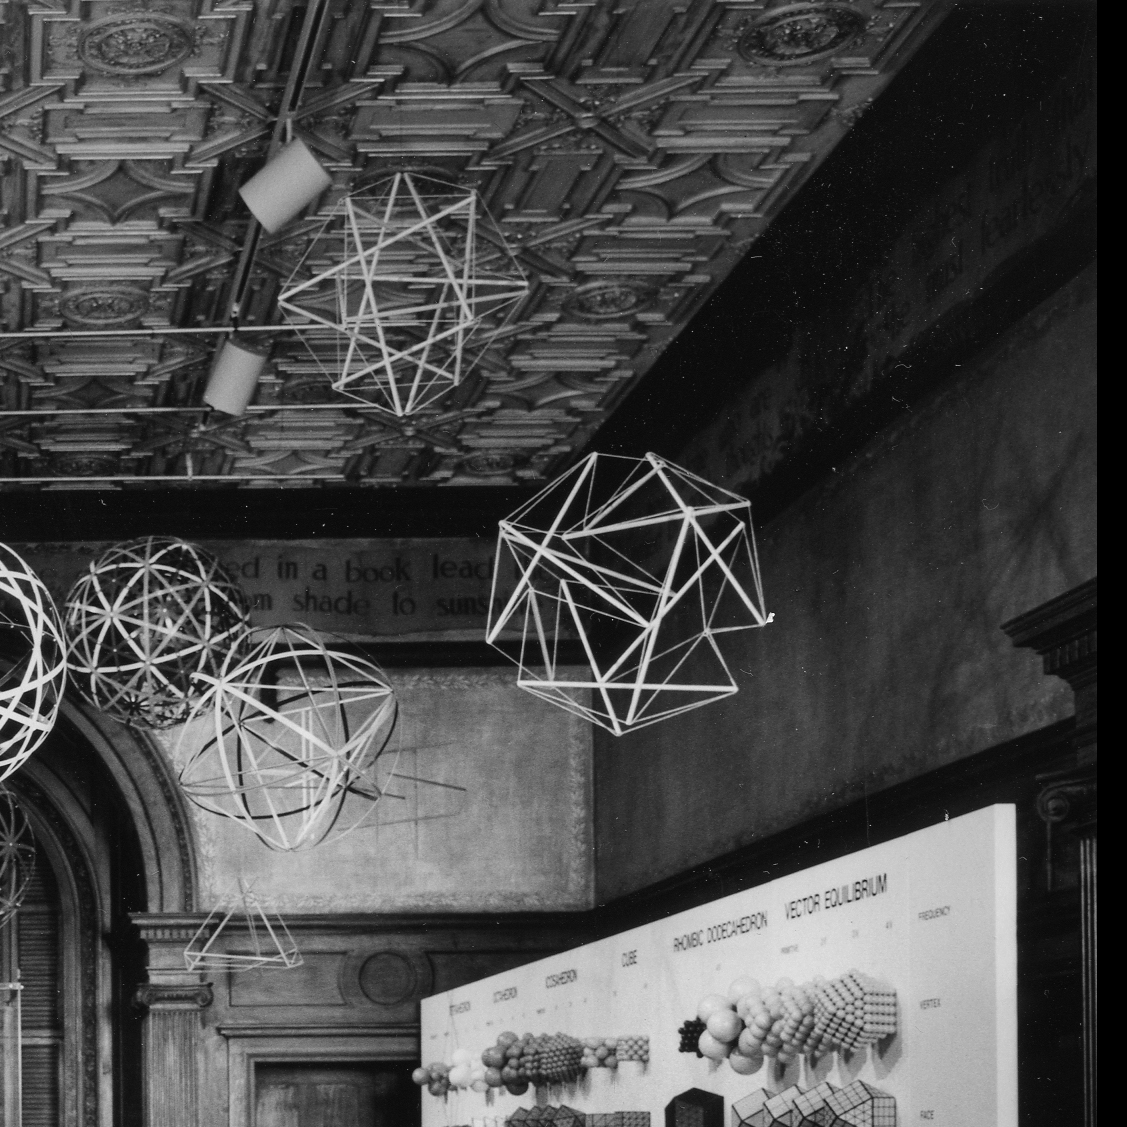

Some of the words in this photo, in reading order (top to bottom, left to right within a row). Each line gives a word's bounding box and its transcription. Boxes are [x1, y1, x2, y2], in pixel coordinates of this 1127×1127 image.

[277, 554, 299, 580] in
[311, 562, 328, 582] a
[345, 558, 412, 583] book
[292, 587, 371, 617] shade
[392, 589, 416, 616] to
[621, 949, 638, 968] CUBE
[674, 928, 705, 953] RHOMBIC
[707, 910, 768, 944] DODECAHEDRON
[784, 893, 821, 920] VECTOR
[824, 872, 888, 910] EQUILIBRIUM
[918, 905, 951, 921] FREQUENCY
[920, 998, 941, 1010] VERTEX
[920, 1109, 935, 1120] FACE
